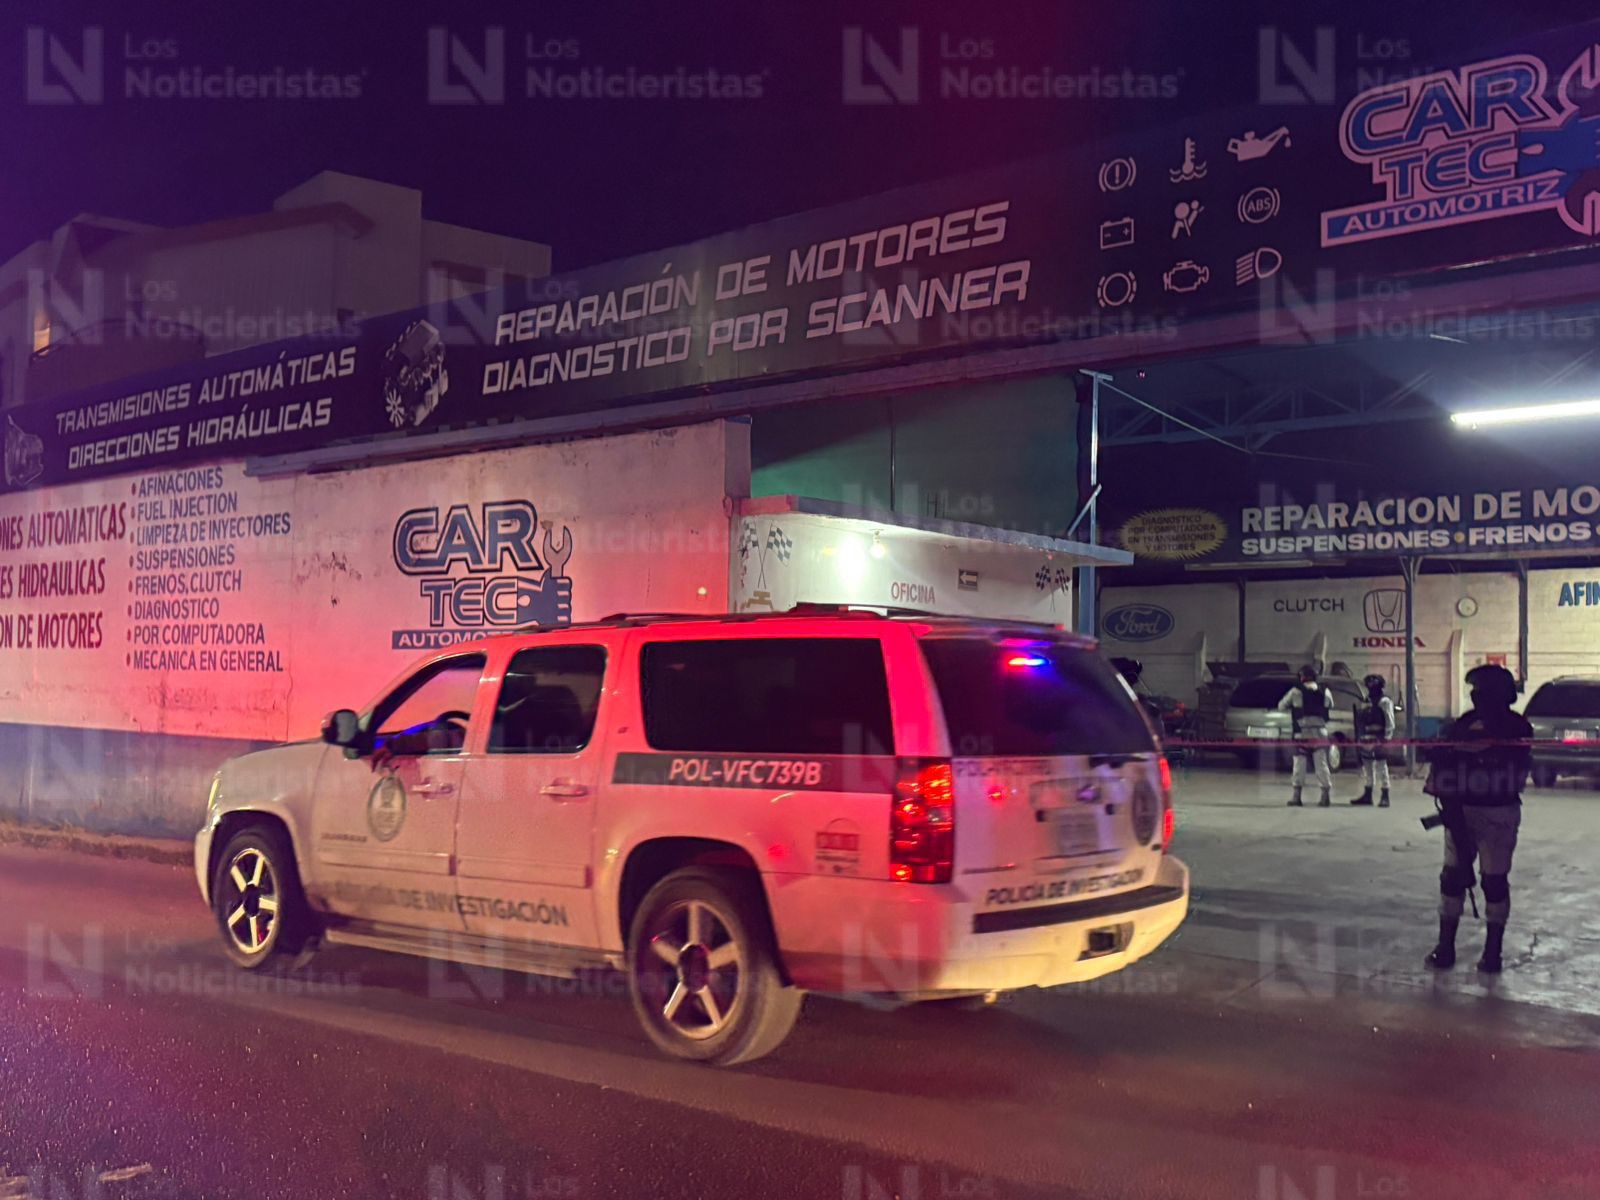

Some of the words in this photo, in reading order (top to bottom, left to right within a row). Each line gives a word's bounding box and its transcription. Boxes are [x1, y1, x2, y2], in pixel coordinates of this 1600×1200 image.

[1341, 55, 1554, 162] CAR
[1376, 134, 1518, 201] TEC
[1246, 196, 1273, 215] ABS
[1343, 180, 1561, 234] AUTOMOTRIZ
[494, 262, 699, 346] REPARACIÓN
[715, 255, 771, 301] DE
[786, 201, 1010, 287] MOTORES
[482, 327, 691, 395] DIAGNOSTICO
[707, 307, 789, 357] POR
[806, 260, 1031, 339] SCANNER
[56, 383, 191, 434] TRANSMISIONES
[198, 346, 357, 405] AUTOMÁTICAS
[68, 427, 181, 470] DIRECCIONES
[187, 398, 332, 448] HIDRÁULICAS
[138, 467, 223, 497] AFINACIONES
[137, 502, 166, 521] FUEL
[169, 492, 238, 519] INJECTION
[1242, 495, 1461, 533] REPARACION
[1474, 491, 1522, 521] DE
[1532, 485, 1600, 519] MO
[27, 502, 127, 548] AUTOMATICAS
[136, 524, 188, 546] LIMPIEZA
[190, 521, 205, 541] DE
[208, 512, 291, 540] INYECTORES
[394, 499, 544, 575] CAR
[1242, 529, 1450, 555] SUSPENSIONES
[1469, 521, 1592, 546] FRENOS
[136, 544, 235, 570] SUSPENSIONES
[0, 566, 13, 598] ES
[18, 558, 106, 597] HIDRAULICAS
[890, 581, 936, 605] OFICINA
[134, 597, 220, 620] DIAGNOSTICO
[420, 577, 518, 627] TEC
[1274, 599, 1344, 612] CLUTCH
[17, 613, 33, 648] DE
[37, 611, 103, 649] MOTORES
[134, 625, 159, 645] POR
[162, 623, 265, 644] COMPUTADORA
[1114, 606, 1161, 635] Ford
[133, 650, 196, 671] MECANICA
[200, 650, 217, 671] EN
[220, 650, 284, 672] GENERAL
[669, 758, 822, 785] POL-VFC739B
